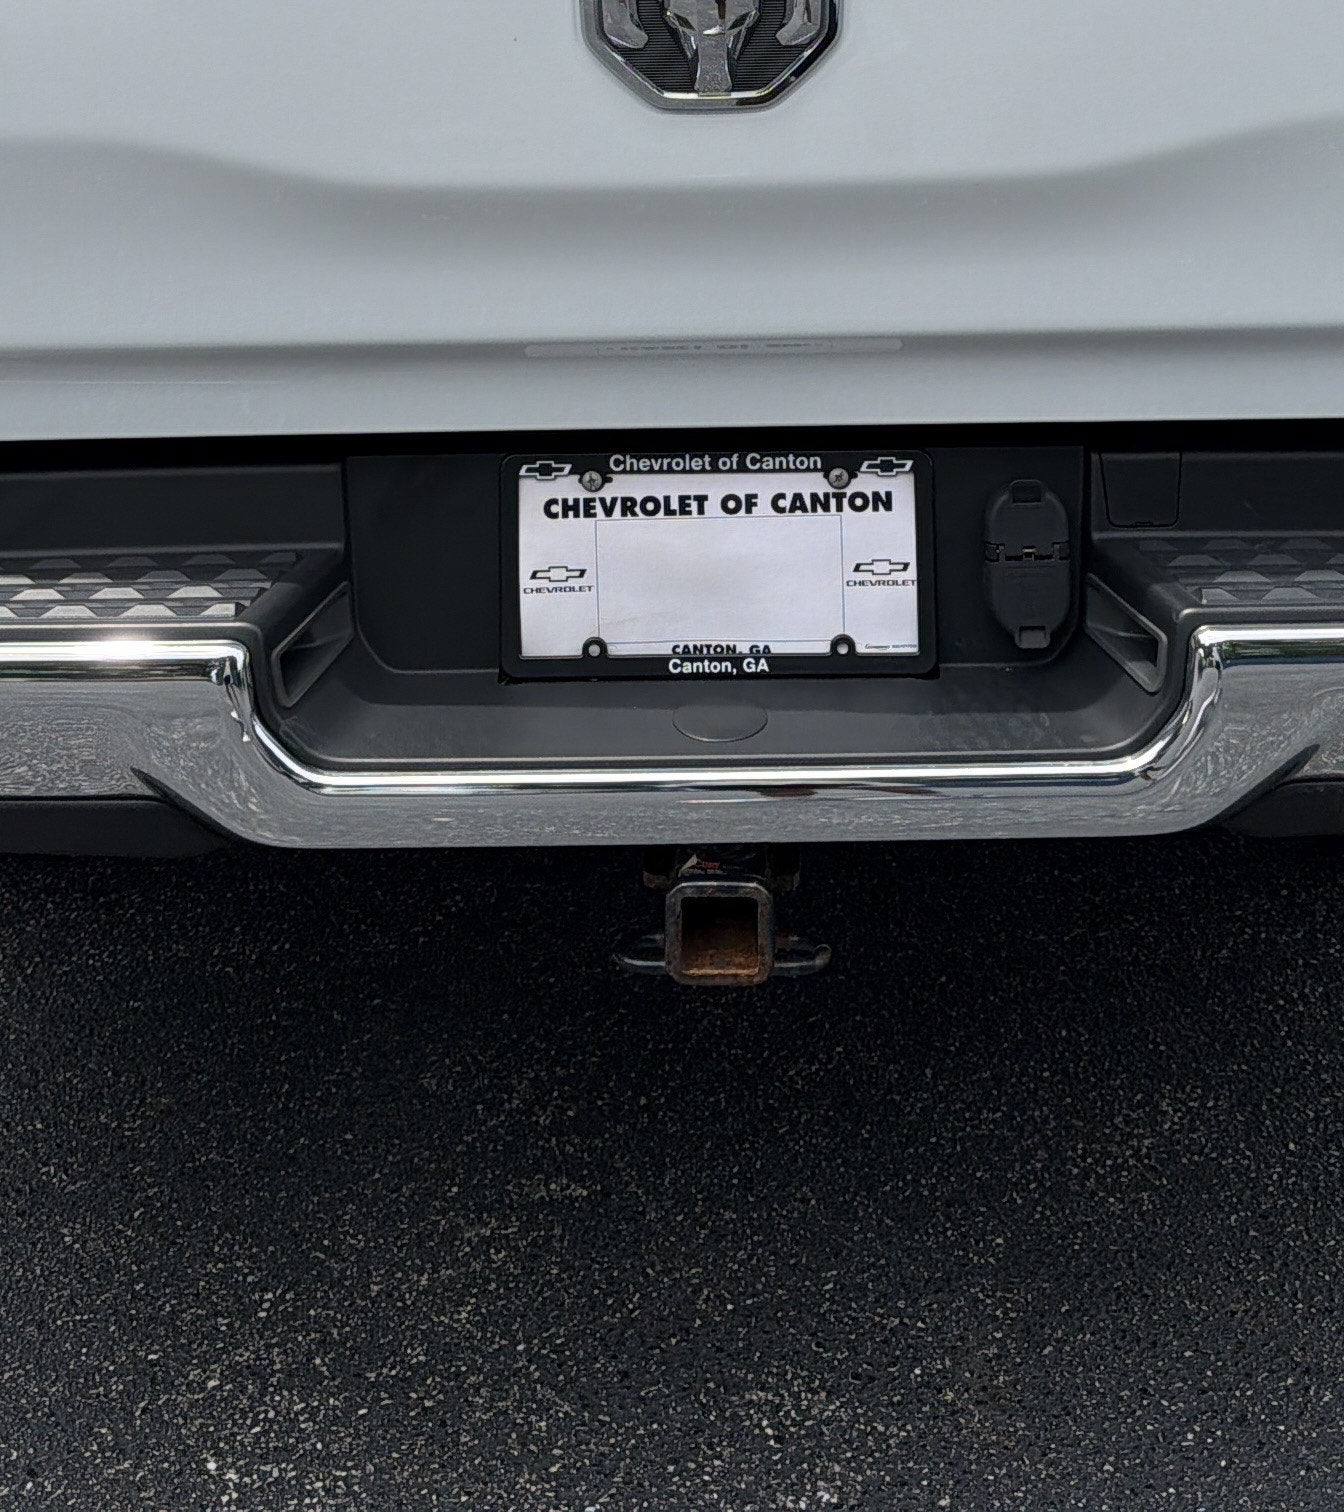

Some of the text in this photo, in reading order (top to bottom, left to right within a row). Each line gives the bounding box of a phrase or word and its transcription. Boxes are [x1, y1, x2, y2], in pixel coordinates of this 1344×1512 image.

[609, 452, 822, 472] Chevrolet of Canton
[543, 490, 893, 519] CHEVROLET OF CANTON
[523, 585, 594, 595] CHEVROLET
[846, 579, 917, 587] CHEVROLET
[749, 644, 772, 655] GA
[668, 657, 770, 676] Canton, GA
